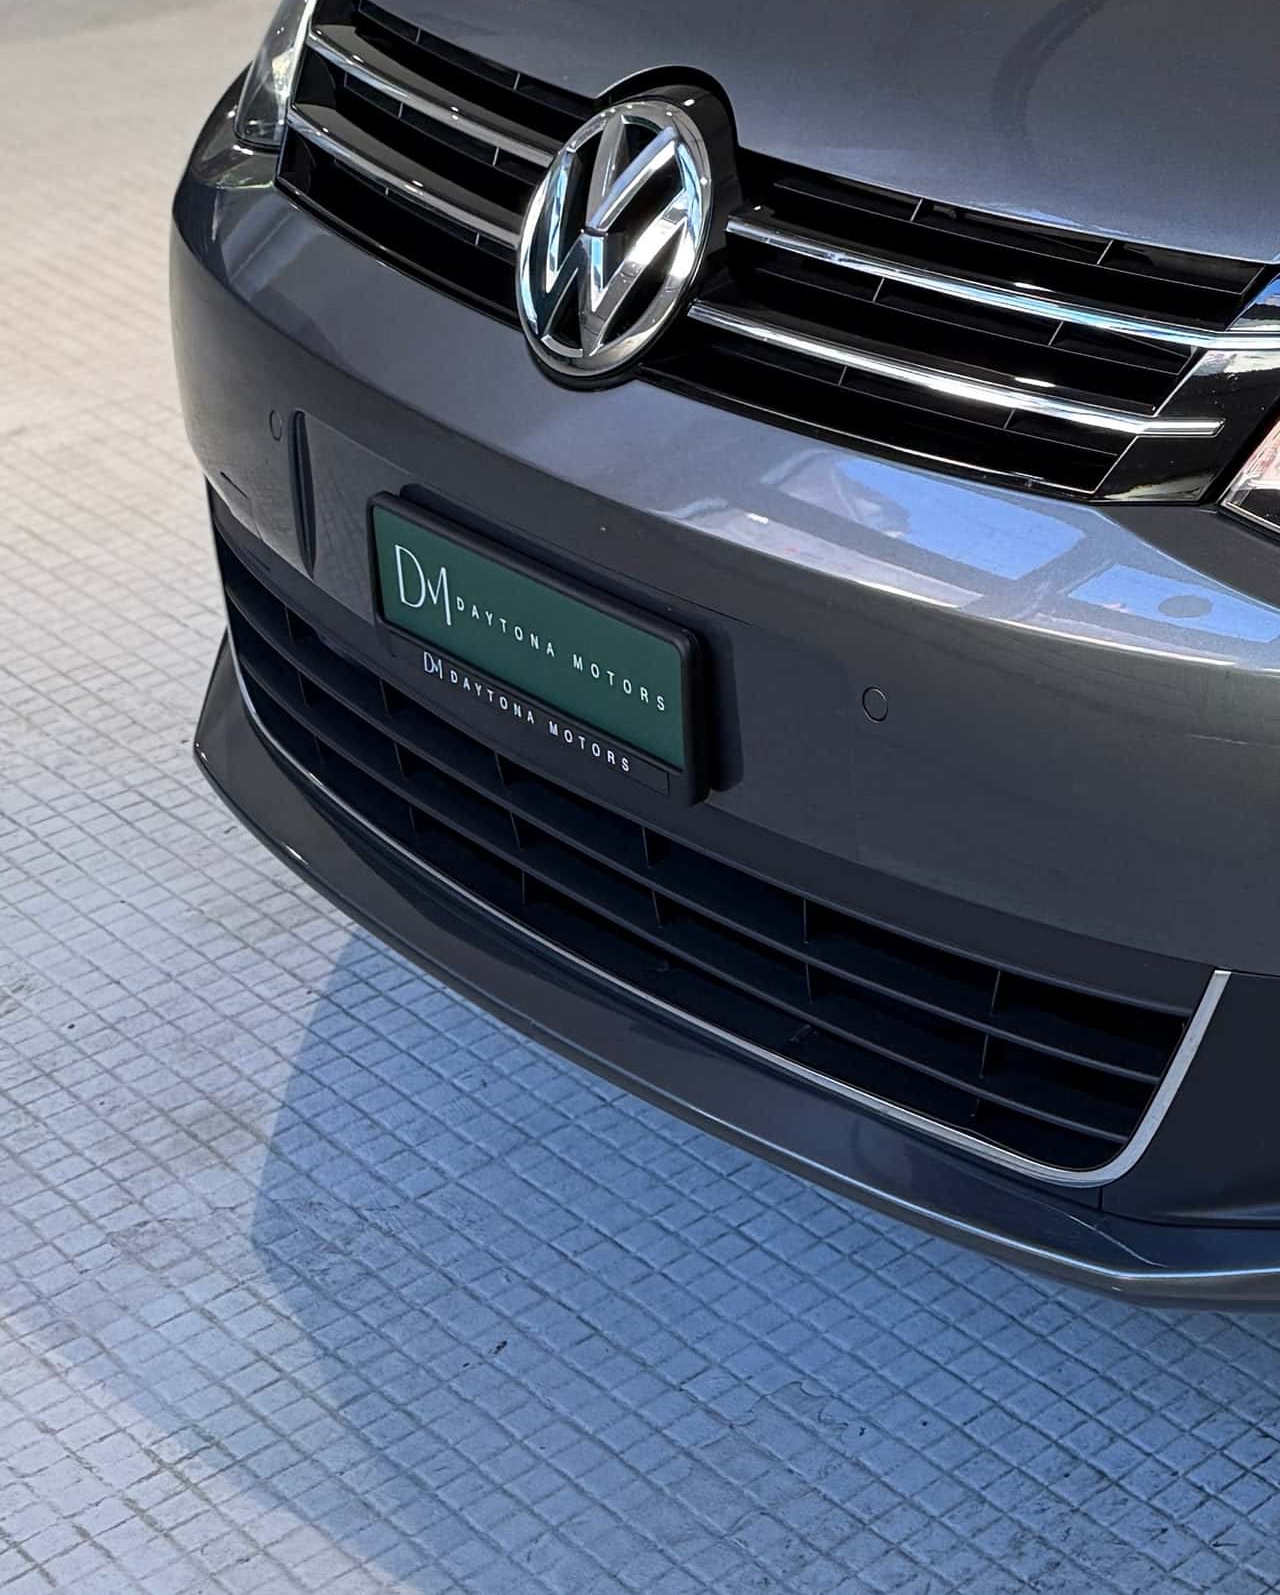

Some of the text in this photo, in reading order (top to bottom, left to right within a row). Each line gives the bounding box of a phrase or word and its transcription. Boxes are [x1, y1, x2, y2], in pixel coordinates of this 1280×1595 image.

[455, 595, 556, 658] DAYTONA
[572, 653, 667, 712] MOTORS
[449, 670, 536, 725] DAYTONA
[548, 719, 632, 773] MOTORS
